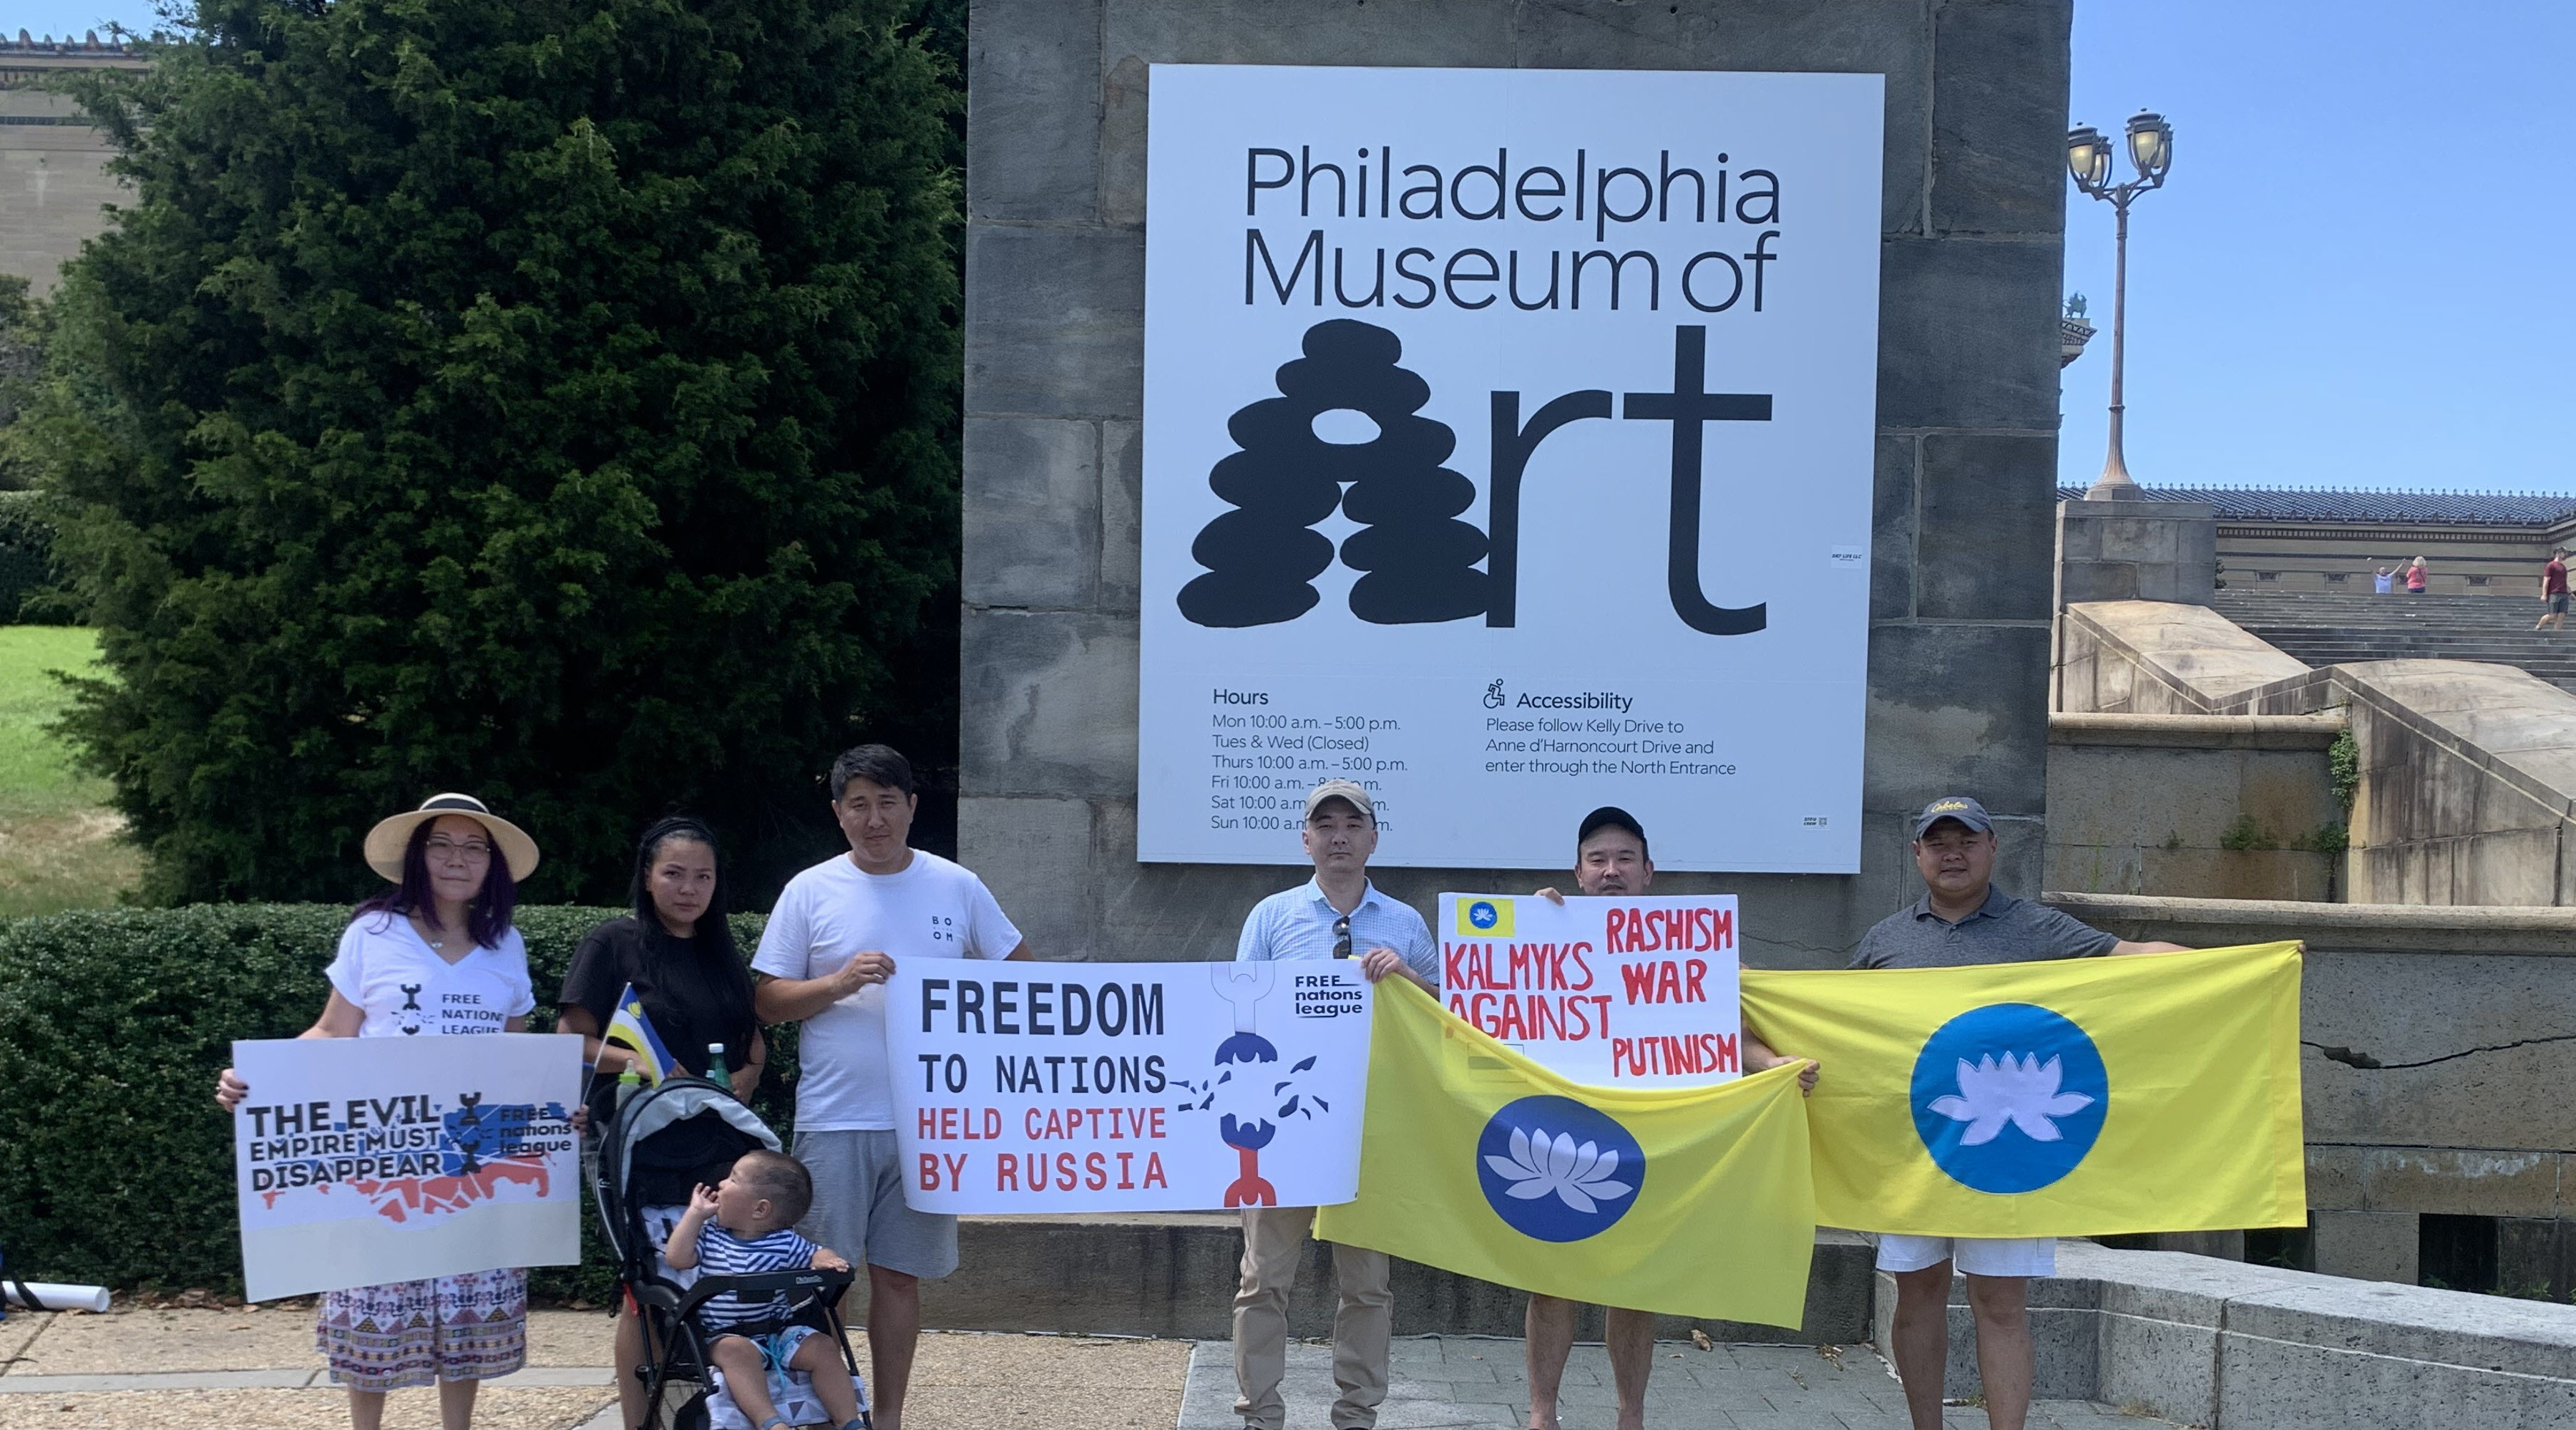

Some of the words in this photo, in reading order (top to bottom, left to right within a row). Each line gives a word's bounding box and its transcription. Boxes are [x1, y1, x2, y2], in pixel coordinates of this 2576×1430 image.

[1247, 145, 1780, 242] Philadelphia
[1245, 228, 1659, 311] Museum
[1682, 230, 1780, 313] of
[1176, 318, 1772, 636] Art
[1213, 689, 1269, 704] Hours
[1516, 692, 1633, 713] Accessibility
[1212, 714, 1246, 728] Mon
[1250, 715, 1287, 729] 10:00
[1291, 718, 1321, 729] a.m.
[1335, 716, 1365, 729] 5:00
[1369, 719, 1401, 733] p.m.
[1486, 718, 1534, 731] Please
[1538, 718, 1583, 732] follow
[1586, 719, 1621, 736] Kelly
[1625, 719, 1664, 733] Drive
[1668, 721, 1684, 733] to
[1212, 734, 1246, 748] Tues
[1251, 735, 1263, 748] &
[1267, 735, 1304, 749] Wed
[1307, 736, 1369, 752] (Closed)
[1485, 739, 1526, 752] Anne
[1530, 739, 1638, 754] d'Harnoncourt
[1642, 740, 1682, 754] Drive
[1685, 741, 1714, 754] and
[1212, 755, 1253, 769] Thurs
[1257, 756, 1294, 769] 10:00
[1298, 759, 1328, 770] a.m.
[1342, 757, 1372, 771] 5:00
[1376, 759, 1407, 774] p.m.
[1485, 760, 1526, 772] enter
[1528, 759, 1589, 777] through
[1592, 759, 1617, 773] the
[1621, 760, 1666, 774] North
[1670, 761, 1736, 775] Entrance
[1212, 775, 1229, 788] Fri
[1234, 776, 1270, 789] 10:00
[1274, 779, 1304, 789] a.m.
[1211, 795, 1235, 809] Sat
[1239, 796, 1276, 809] 10:00
[1211, 815, 1239, 830] Sun
[1243, 817, 1279, 830] 10:00
[1606, 908, 1732, 955] RASHISM
[1444, 941, 1593, 991] KALMYKS
[1295, 976, 1361, 988] FREE
[1621, 959, 1707, 1005] WAR
[442, 993, 481, 1004] FREE
[1295, 990, 1362, 1001] nations
[922, 979, 1164, 1036] FREEDOM
[1296, 1003, 1362, 1018] league
[1449, 993, 1612, 1041] AGAINST
[1613, 1033, 1738, 1077] PUTINISM
[919, 1054, 967, 1093] TO
[996, 1055, 1166, 1094] NATIONS
[247, 1101, 331, 1138] THE
[347, 1094, 442, 1129] EVIL
[500, 1108, 565, 1122] FREE
[919, 1108, 1002, 1139] HELD
[1025, 1107, 1166, 1139] CAPTIVE
[500, 1124, 572, 1138] nations
[250, 1134, 356, 1162] EMPIRE
[367, 1127, 441, 1152] MUST
[500, 1140, 572, 1157] league
[252, 1154, 441, 1191] DISAPPEAR
[919, 1153, 968, 1192] BY
[997, 1152, 1168, 1192] RUSSIA
